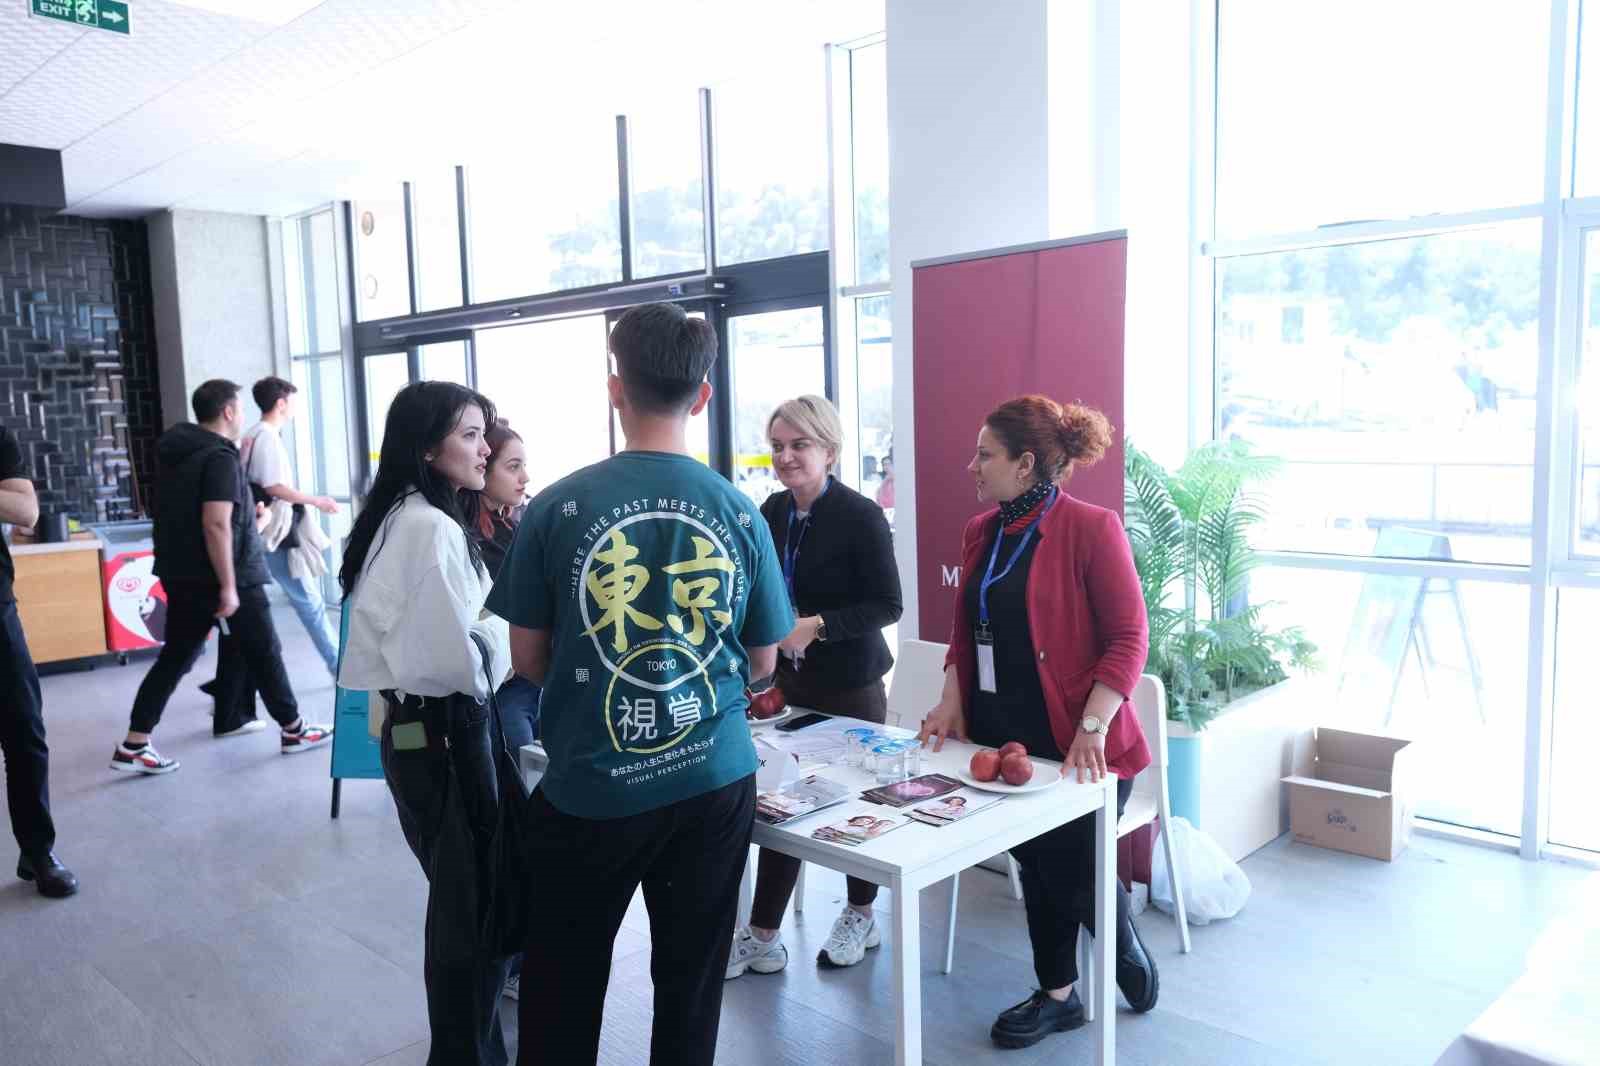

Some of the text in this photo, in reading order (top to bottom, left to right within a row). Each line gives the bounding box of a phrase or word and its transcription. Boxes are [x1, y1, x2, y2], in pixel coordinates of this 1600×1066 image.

[40, 2, 71, 17] EXIT
[584, 516, 610, 541] THE
[613, 499, 649, 518] PAST
[657, 498, 705, 518] MEETS
[710, 518, 731, 543] THE
[579, 527, 736, 653] 東京
[647, 658, 677, 672] TOKYO
[626, 756, 707, 785] VISUAL PERCEPTION
